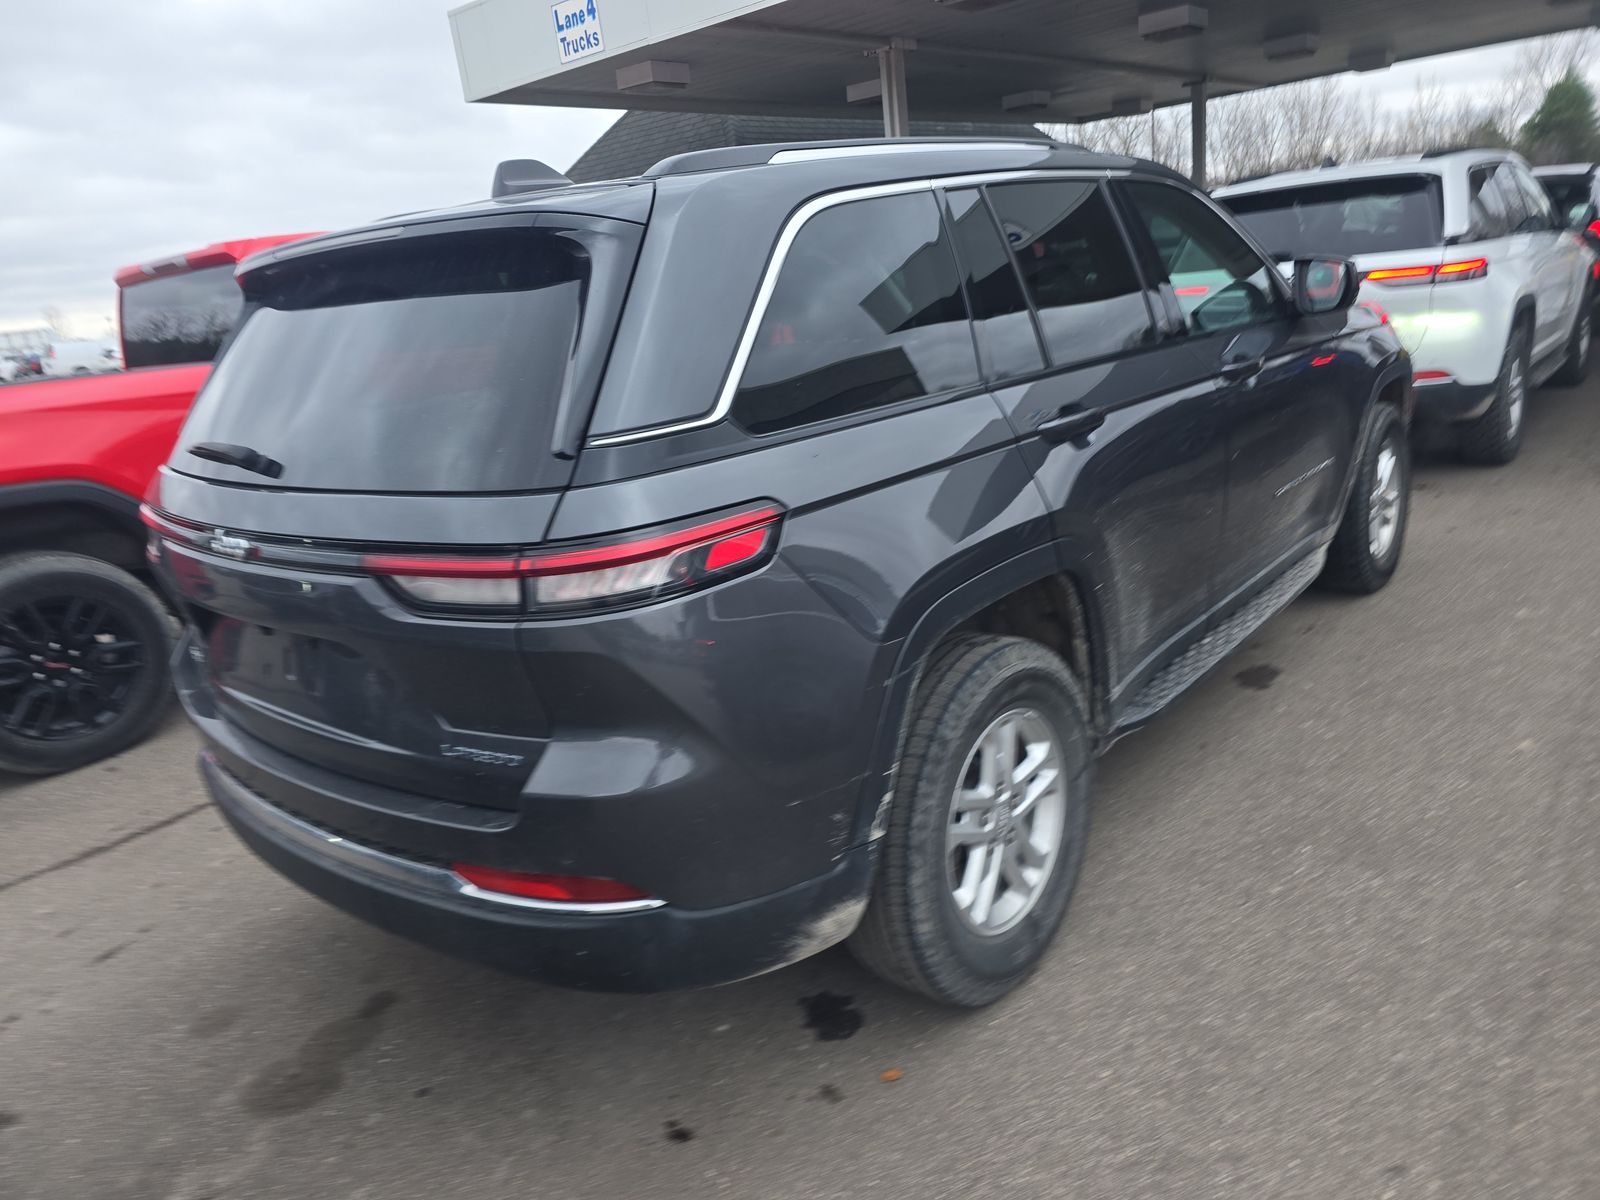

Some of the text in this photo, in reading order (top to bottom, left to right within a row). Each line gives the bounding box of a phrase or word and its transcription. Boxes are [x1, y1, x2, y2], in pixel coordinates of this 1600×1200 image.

[554, 0, 596, 32] Lane 4
[560, 29, 600, 57] Trucks
